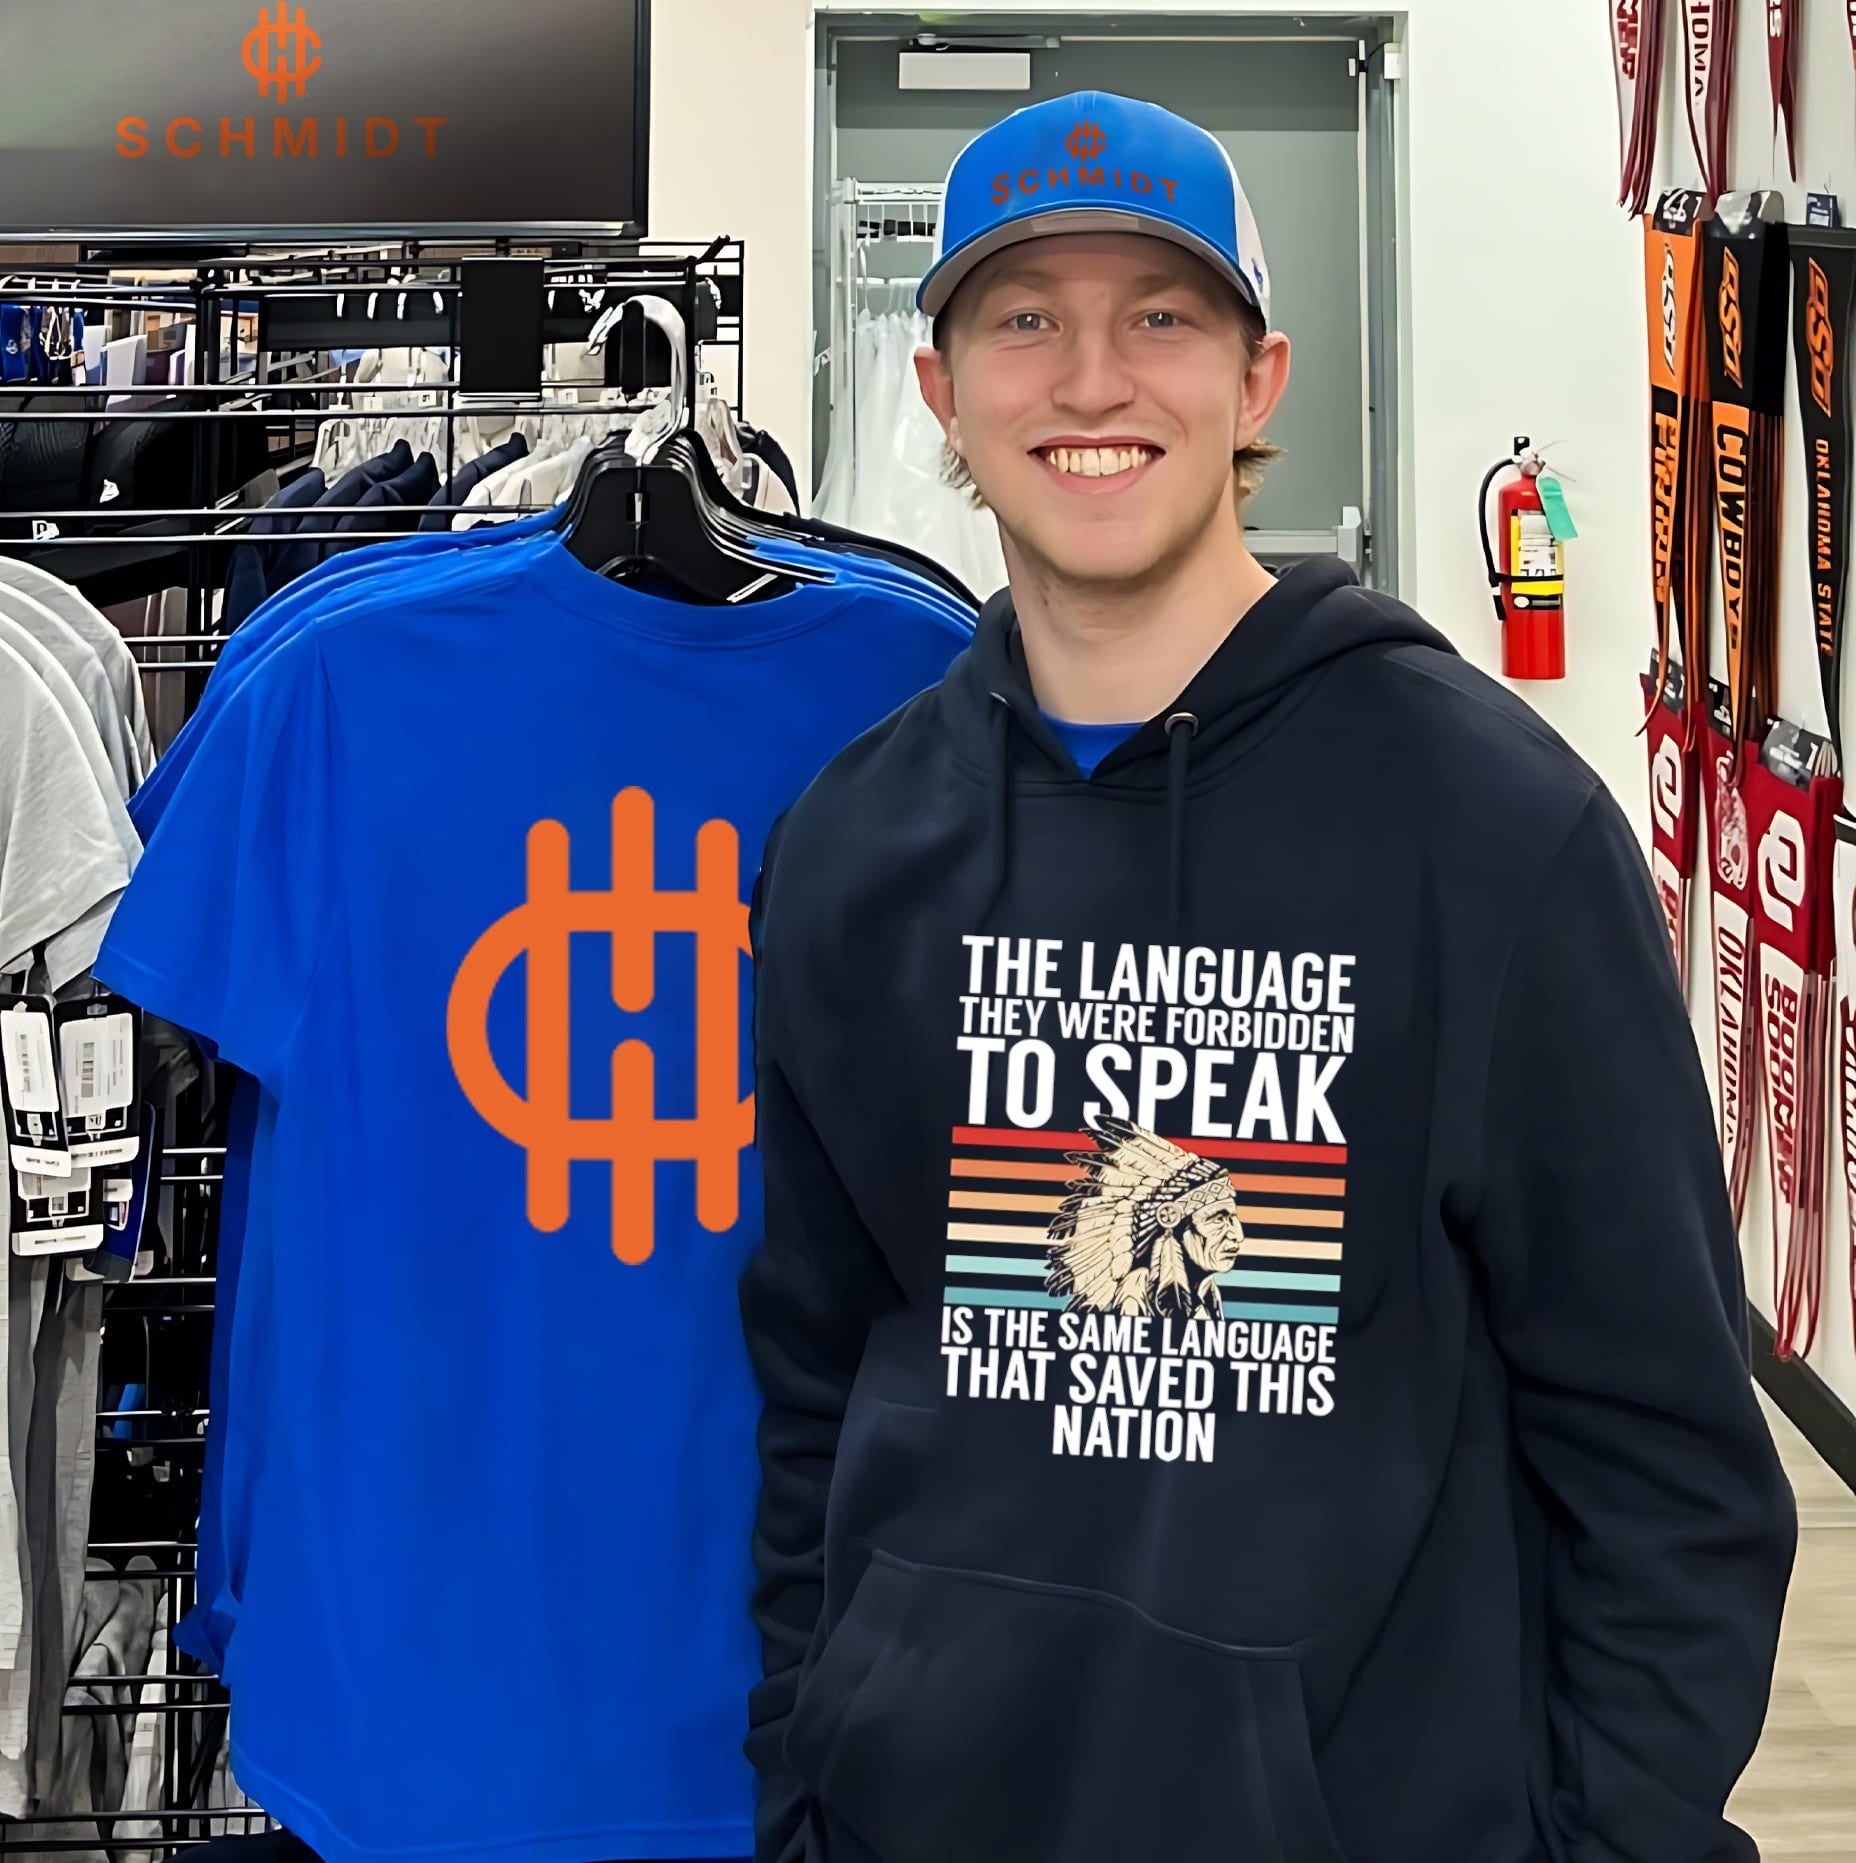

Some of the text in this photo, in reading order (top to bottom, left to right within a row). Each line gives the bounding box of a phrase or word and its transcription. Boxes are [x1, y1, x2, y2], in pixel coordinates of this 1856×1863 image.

[1690, 2, 1710, 97] OMA
[116, 116, 448, 159] SCHMIDT
[991, 167, 1179, 204] SCHMIDT
[962, 935, 1356, 1014] THE LANGUAGE
[959, 996, 1355, 1054] THEY WERE FORBIDDEN
[956, 1036, 1348, 1145] TO SPEAK
[941, 1306, 1337, 1364] IS THE SAME LANGUAGE
[940, 1346, 1336, 1417] THAT SAVED THIS
[1052, 1404, 1216, 1463] NATION
